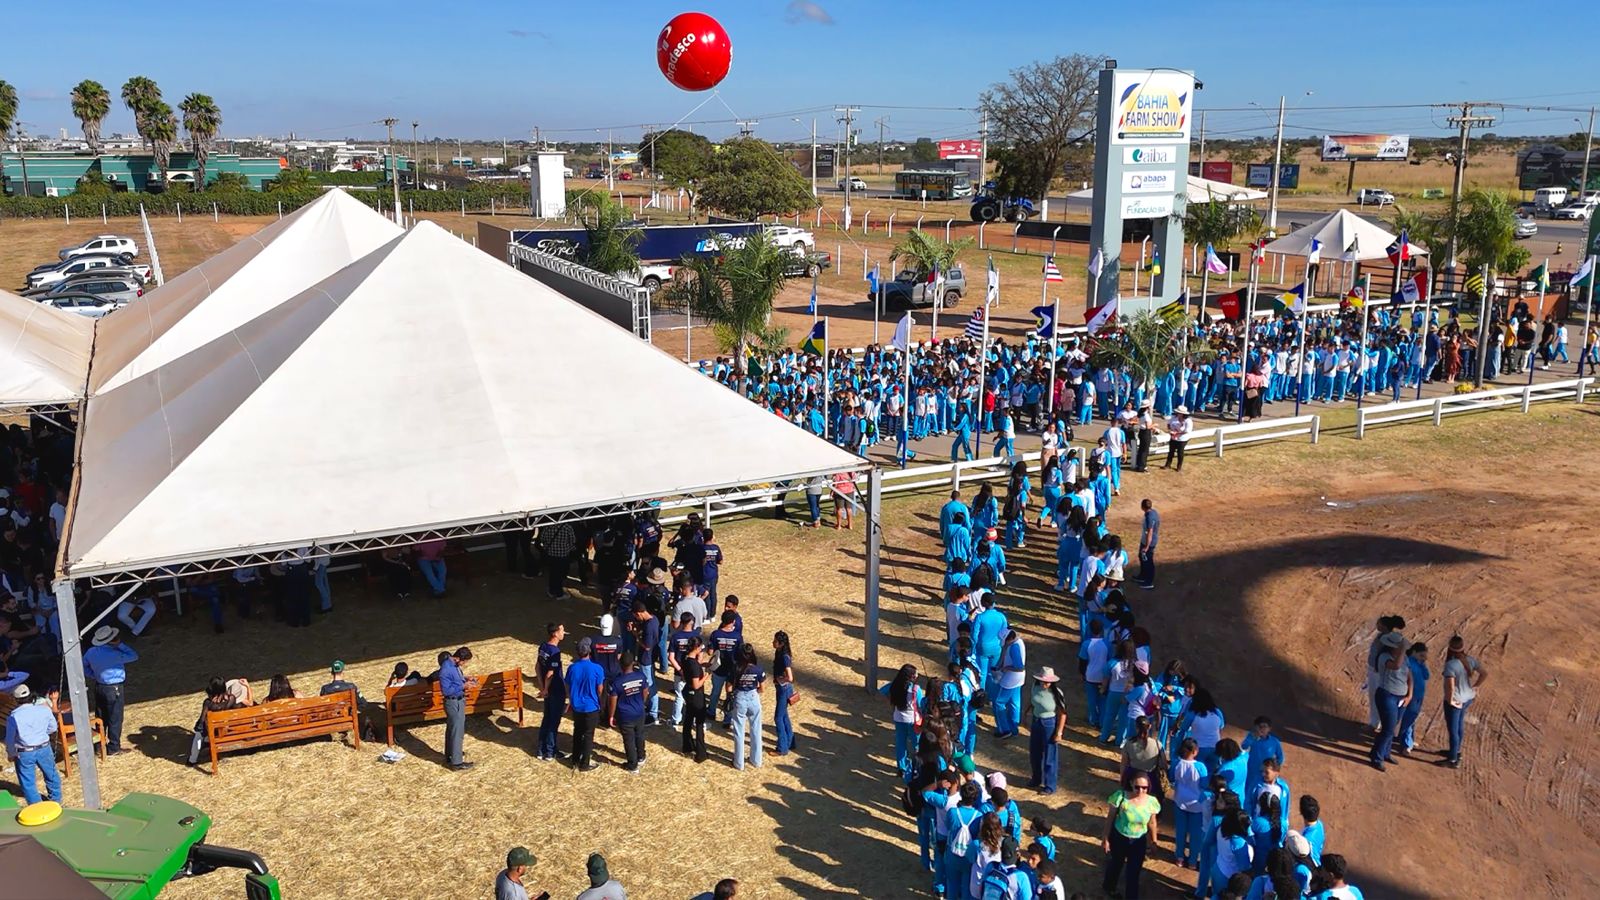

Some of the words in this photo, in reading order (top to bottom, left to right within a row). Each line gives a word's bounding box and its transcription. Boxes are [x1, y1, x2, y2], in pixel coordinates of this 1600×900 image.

[666, 33, 696, 80] bradesco
[1137, 95, 1169, 109] BAHIA
[1126, 111, 1150, 126] FARM
[1151, 111, 1178, 126] SHOW
[1143, 148, 1167, 163] aiba
[1143, 175, 1167, 183] abapa
